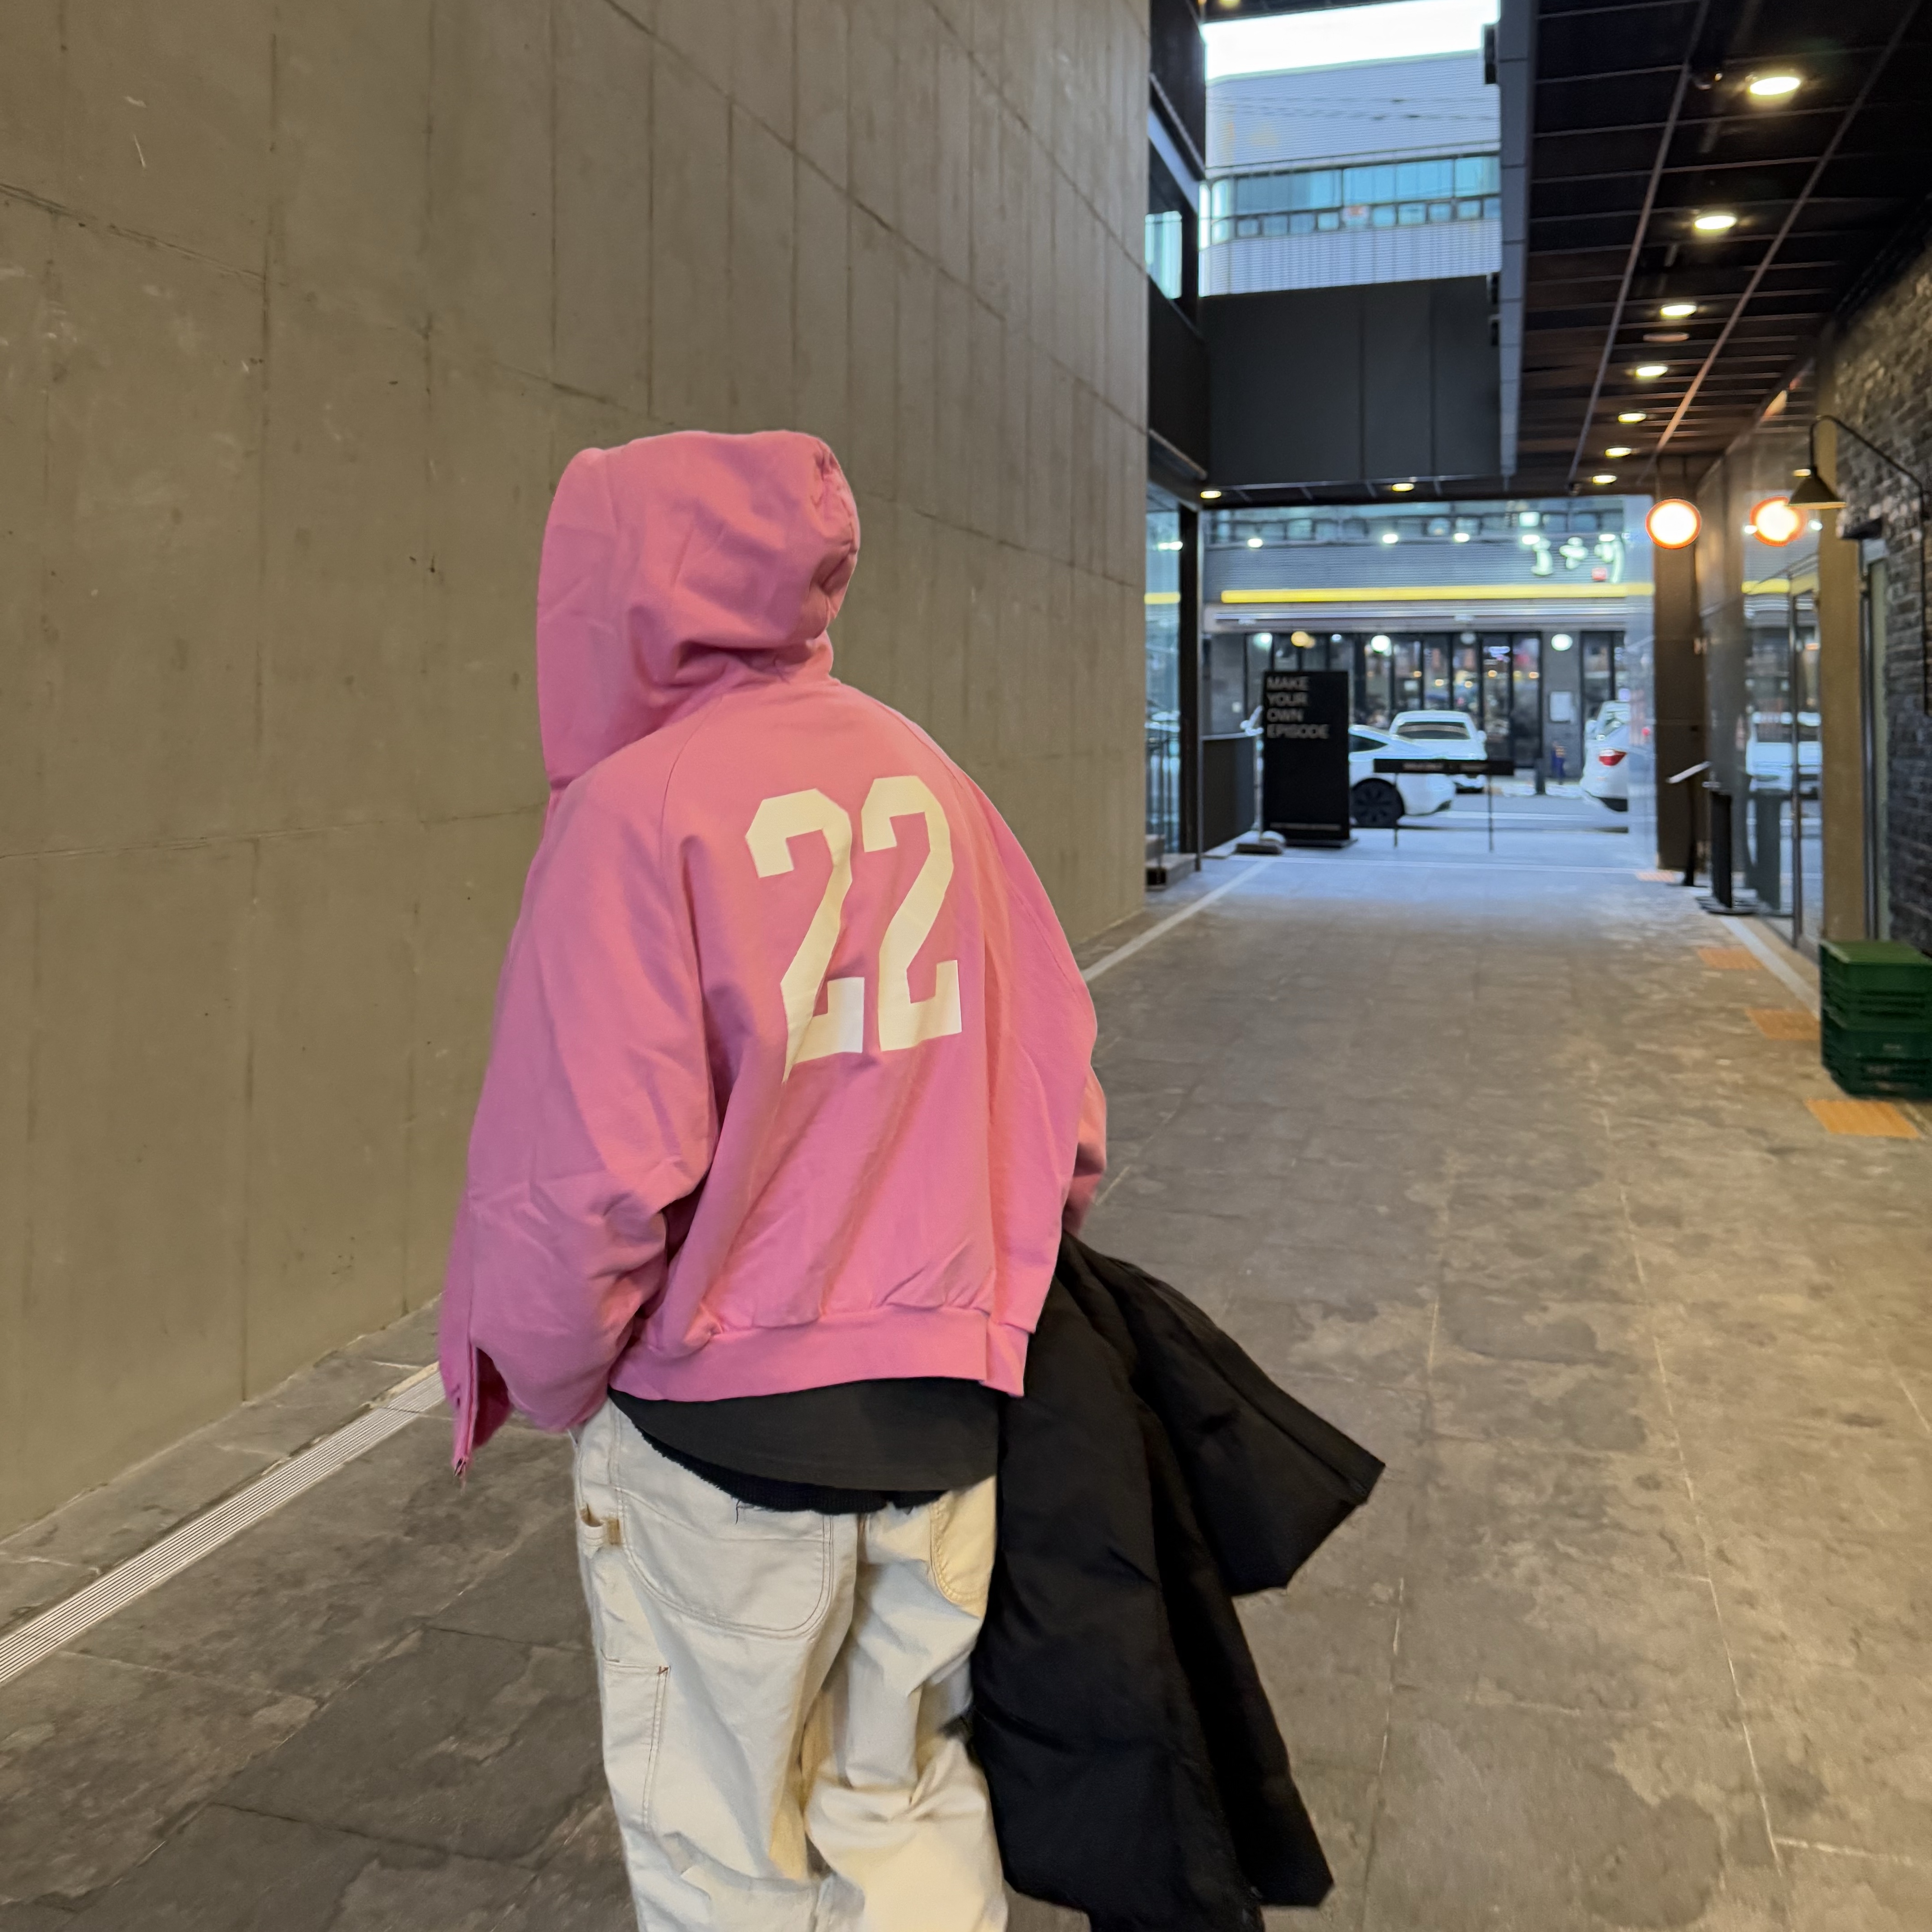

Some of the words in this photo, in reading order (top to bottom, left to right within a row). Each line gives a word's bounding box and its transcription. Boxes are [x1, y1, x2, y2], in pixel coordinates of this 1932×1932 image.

[1267, 676, 1309, 690] MAKE
[1267, 692, 1308, 707] YOUR
[1267, 708, 1304, 722] OWN
[745, 775, 962, 1084] 22
